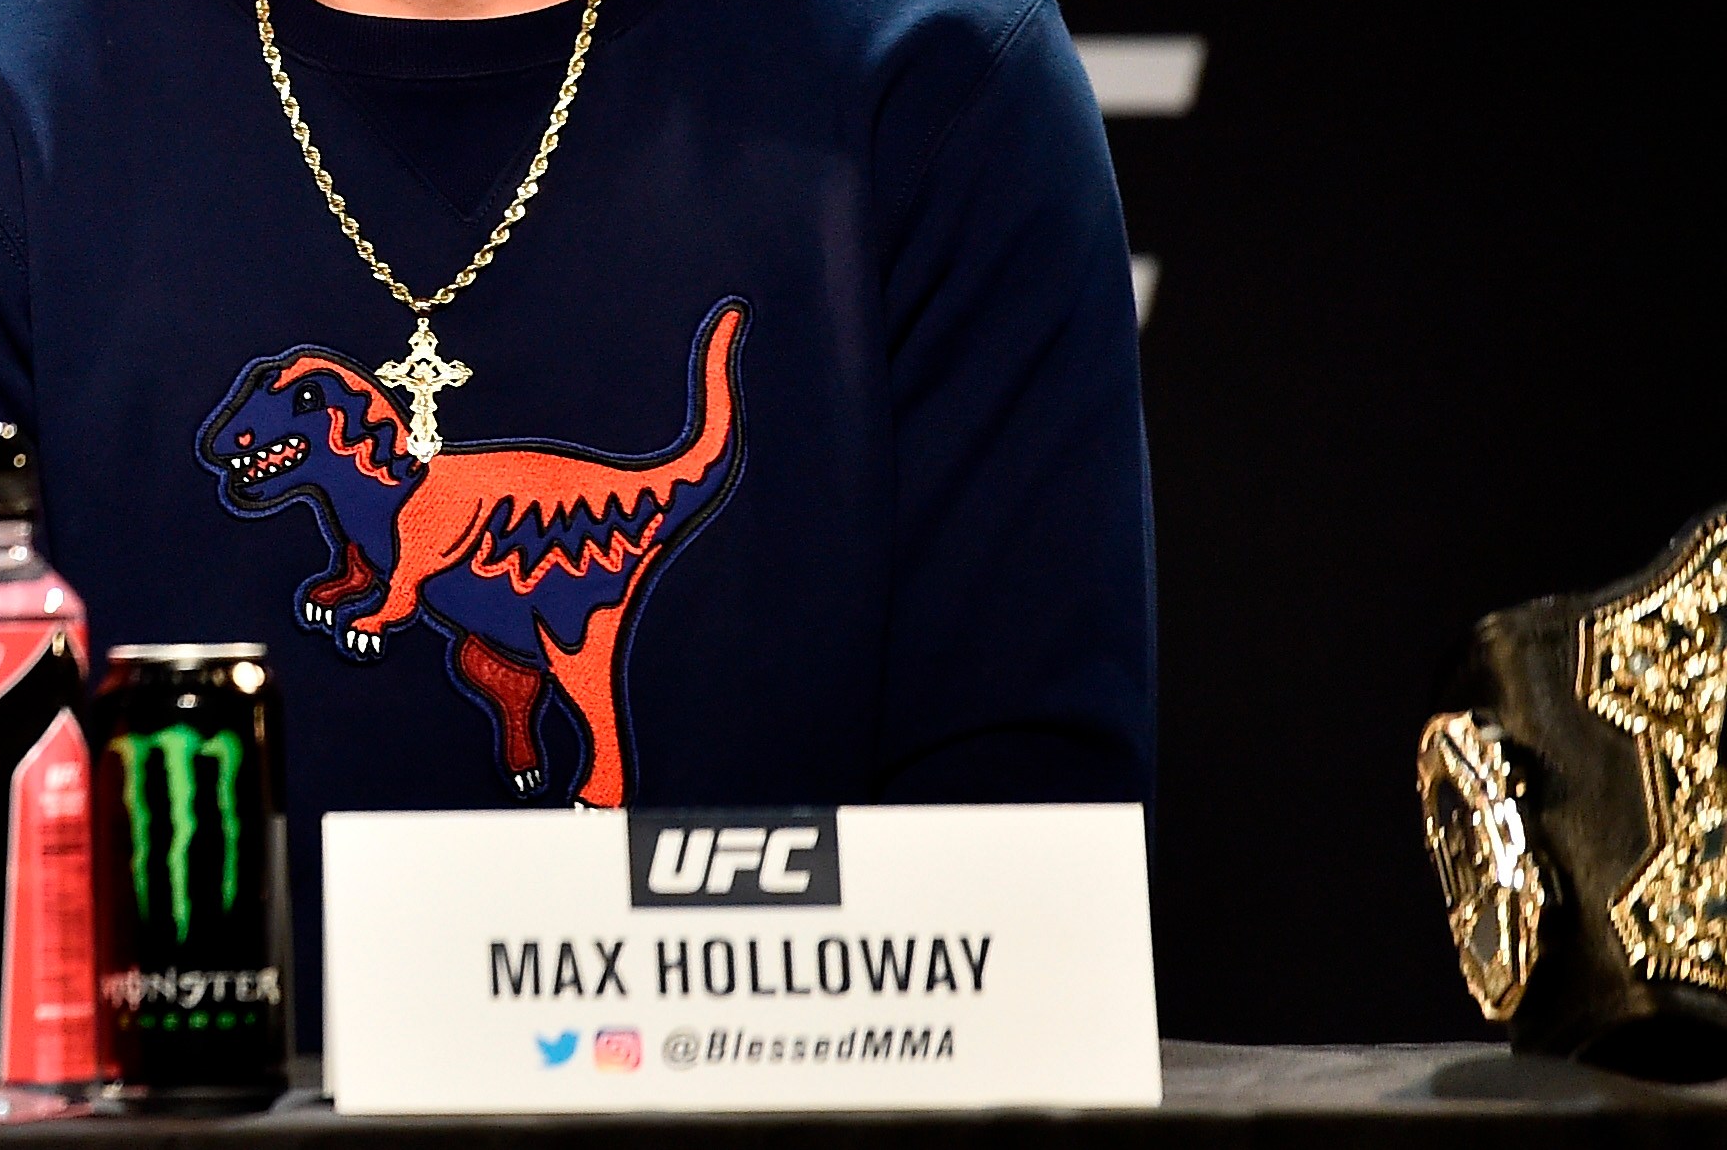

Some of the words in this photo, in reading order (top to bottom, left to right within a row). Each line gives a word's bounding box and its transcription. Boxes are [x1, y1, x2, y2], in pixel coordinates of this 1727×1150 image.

[647, 826, 821, 895] UFC
[99, 964, 283, 1011] MONSTER
[489, 939, 628, 997] MAX
[656, 936, 992, 997] HOLLOWAY
[661, 1028, 957, 1067] @BlessedMMA
